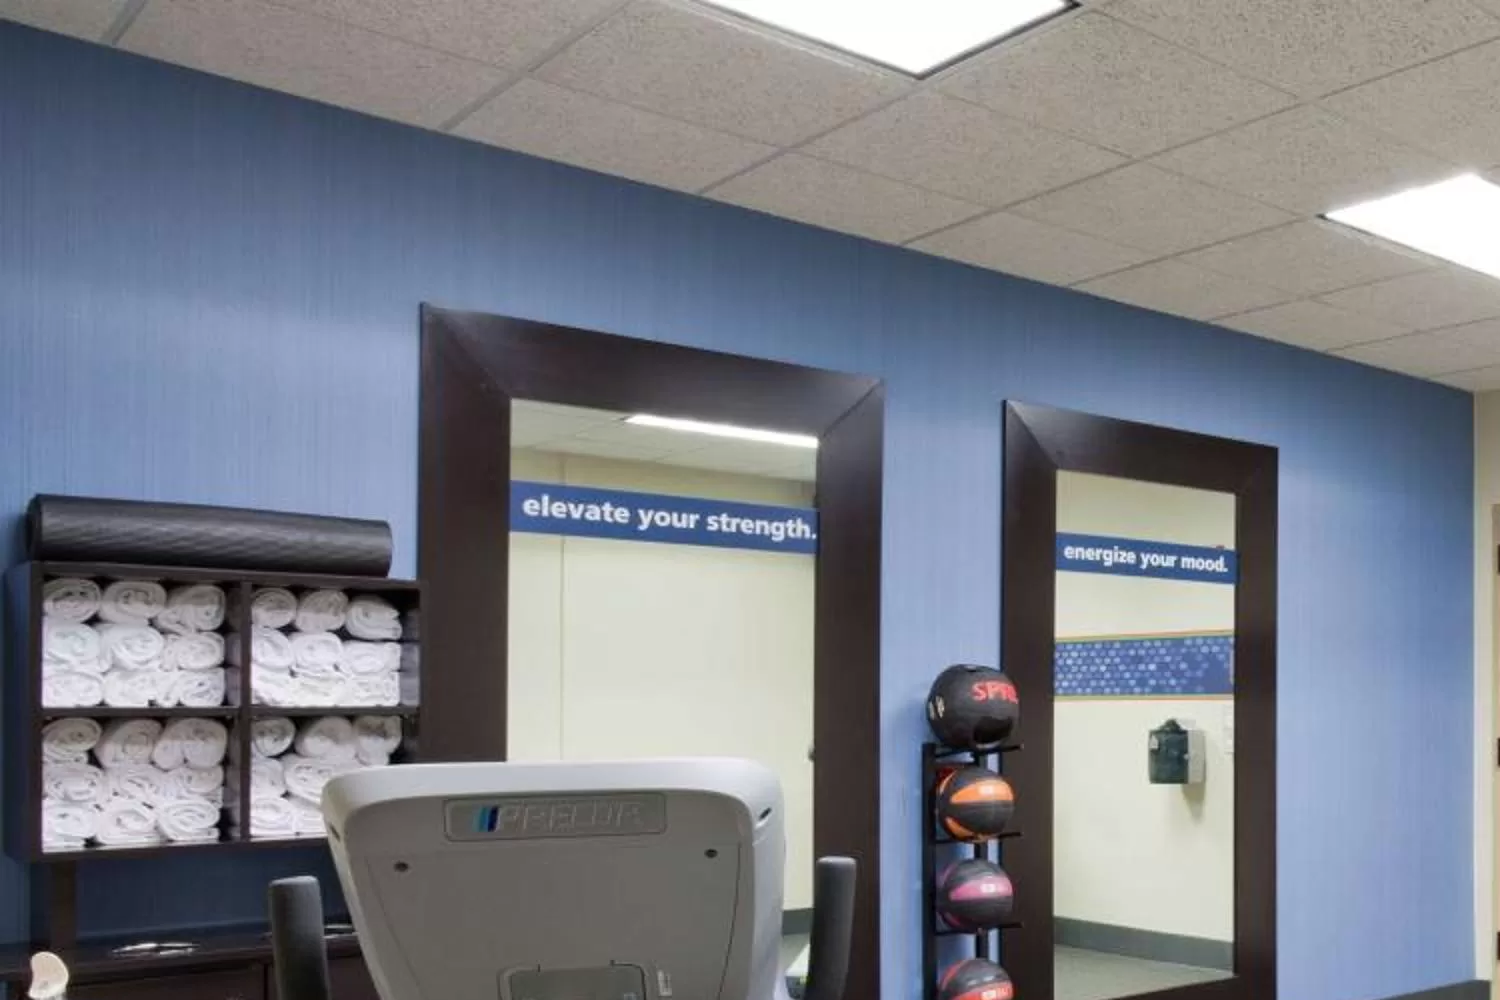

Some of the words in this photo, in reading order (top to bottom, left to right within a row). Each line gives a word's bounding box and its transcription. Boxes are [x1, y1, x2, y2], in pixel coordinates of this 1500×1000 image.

[522, 493, 631, 525] elevate
[638, 508, 700, 531] your
[706, 513, 818, 542] strength.
[1063, 544, 1137, 567] energize
[1140, 551, 1177, 570] your
[1180, 556, 1229, 573] mood.
